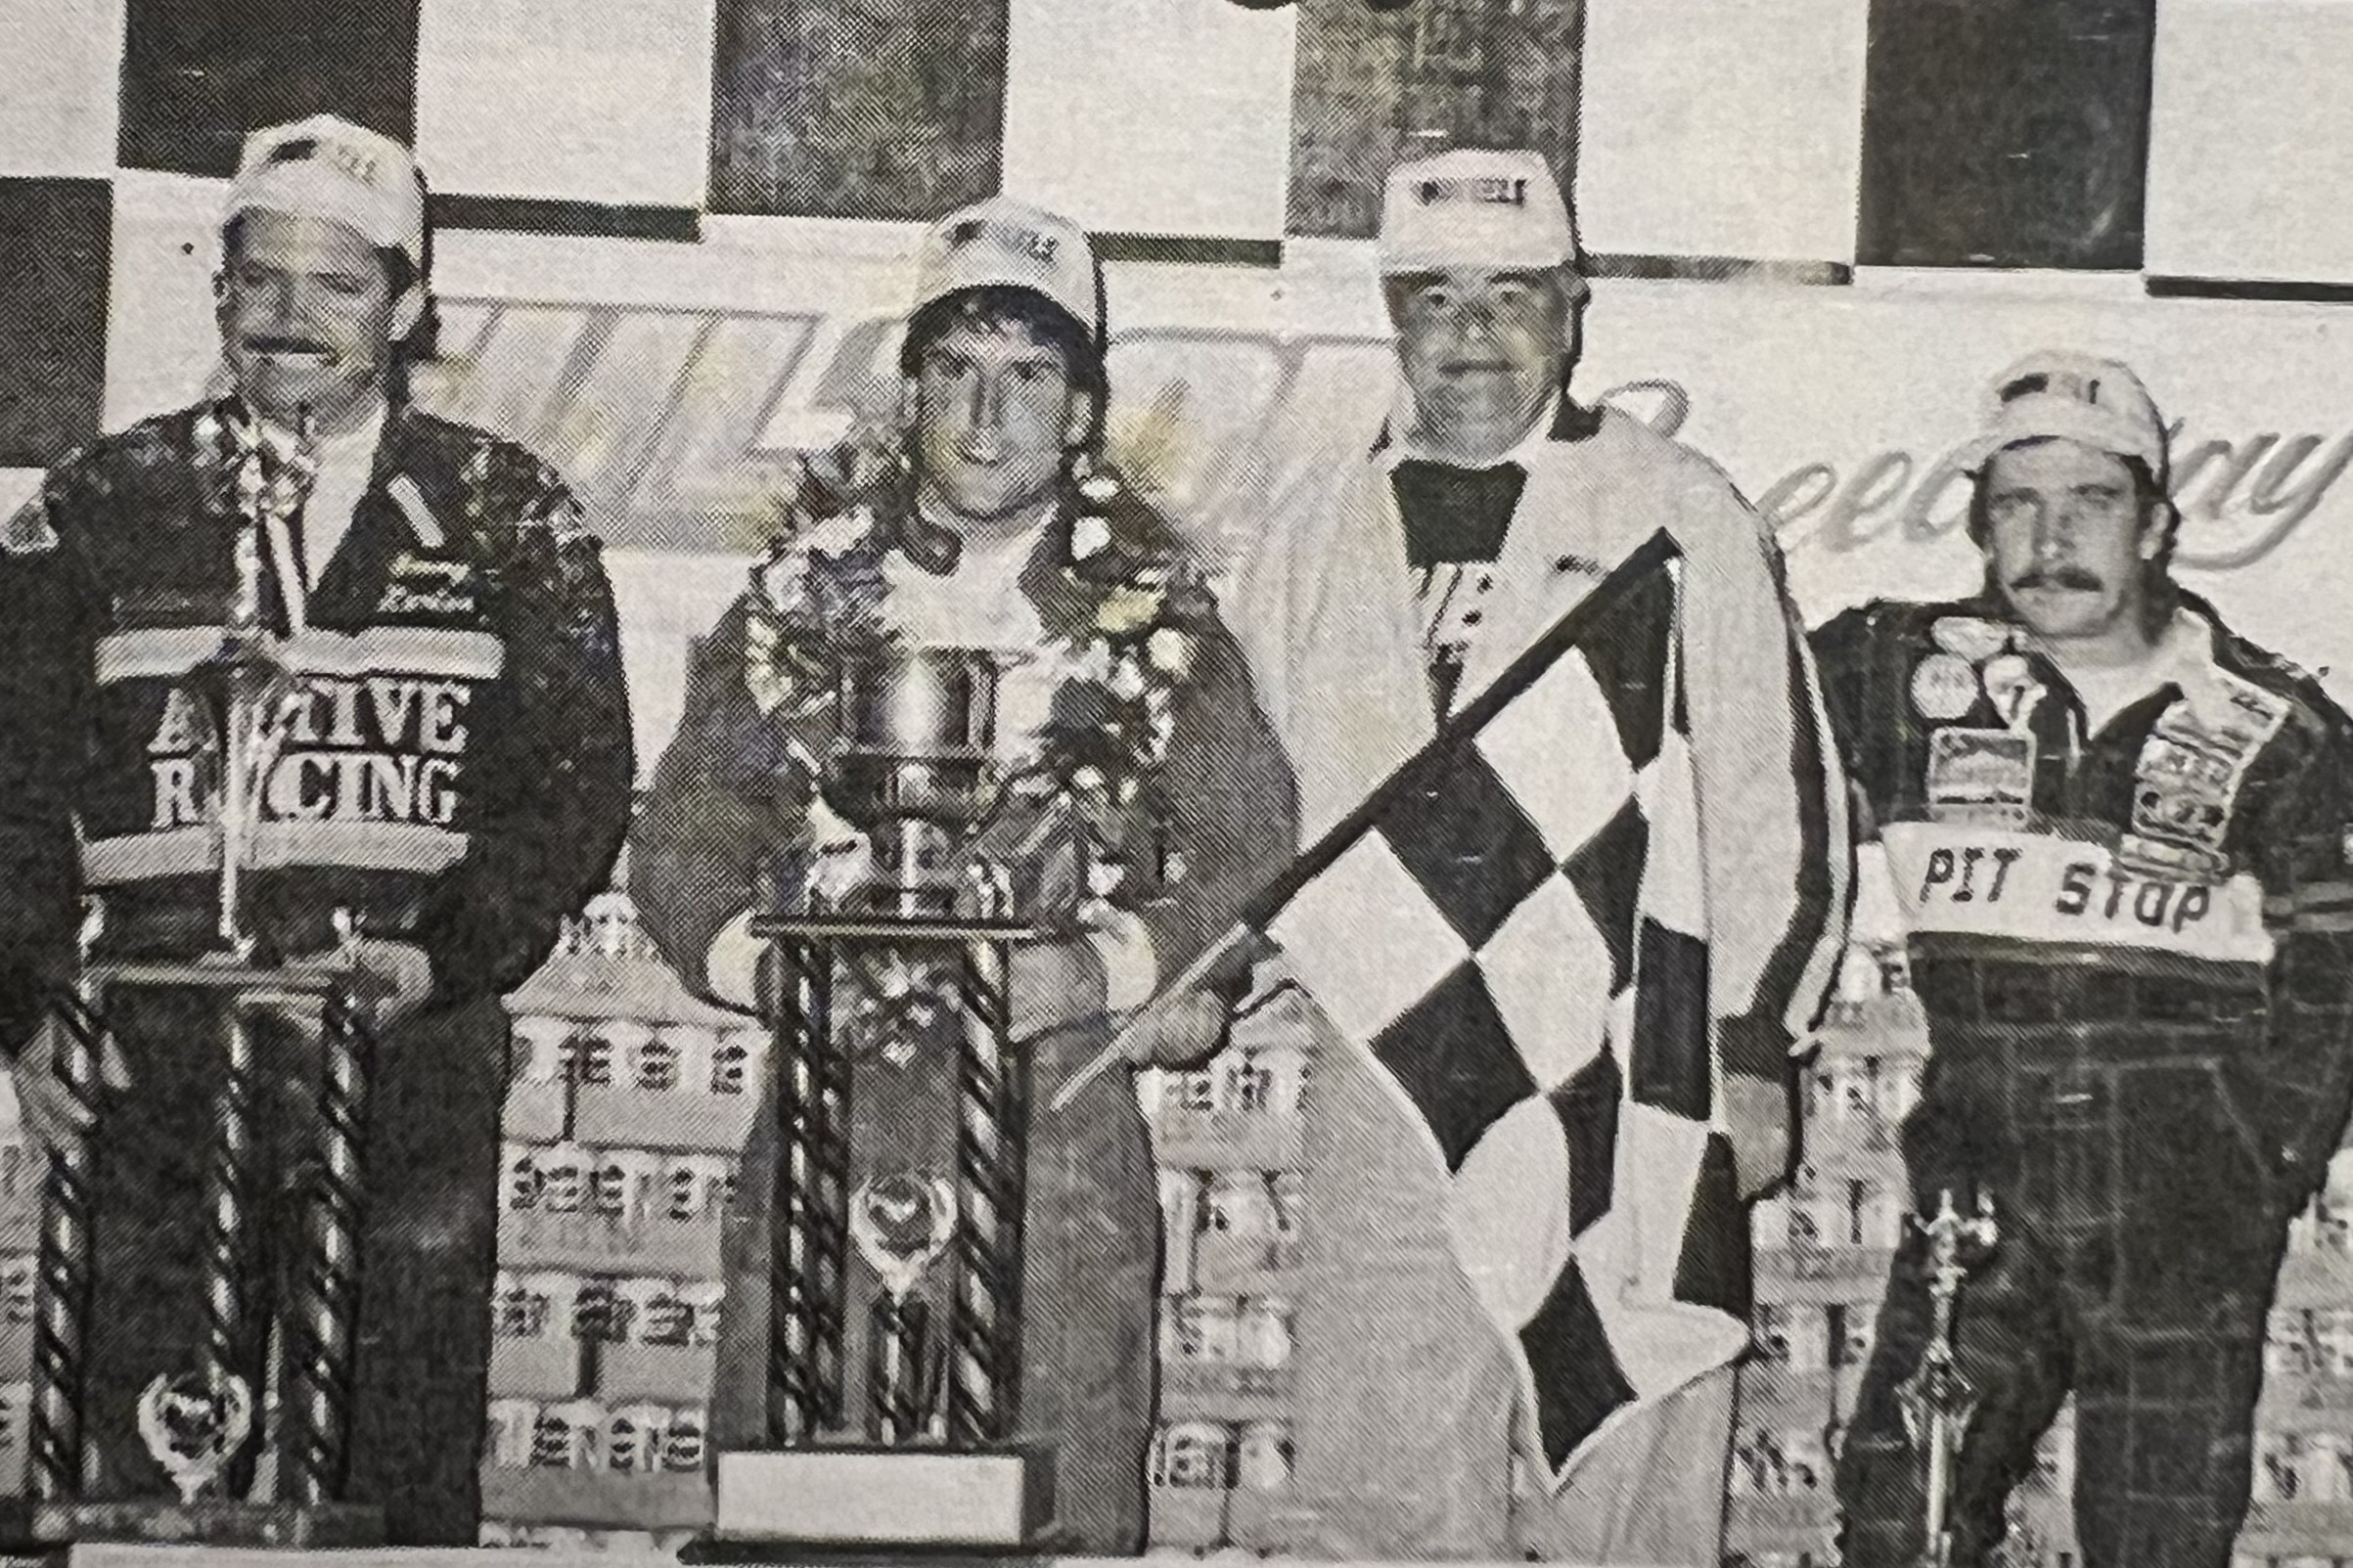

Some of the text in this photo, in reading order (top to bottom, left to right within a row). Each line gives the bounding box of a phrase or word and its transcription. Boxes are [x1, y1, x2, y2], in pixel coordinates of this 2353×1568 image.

[147, 679, 472, 753] ATIVE
[150, 751, 465, 828] RCING
[1920, 848, 2021, 903] PIT
